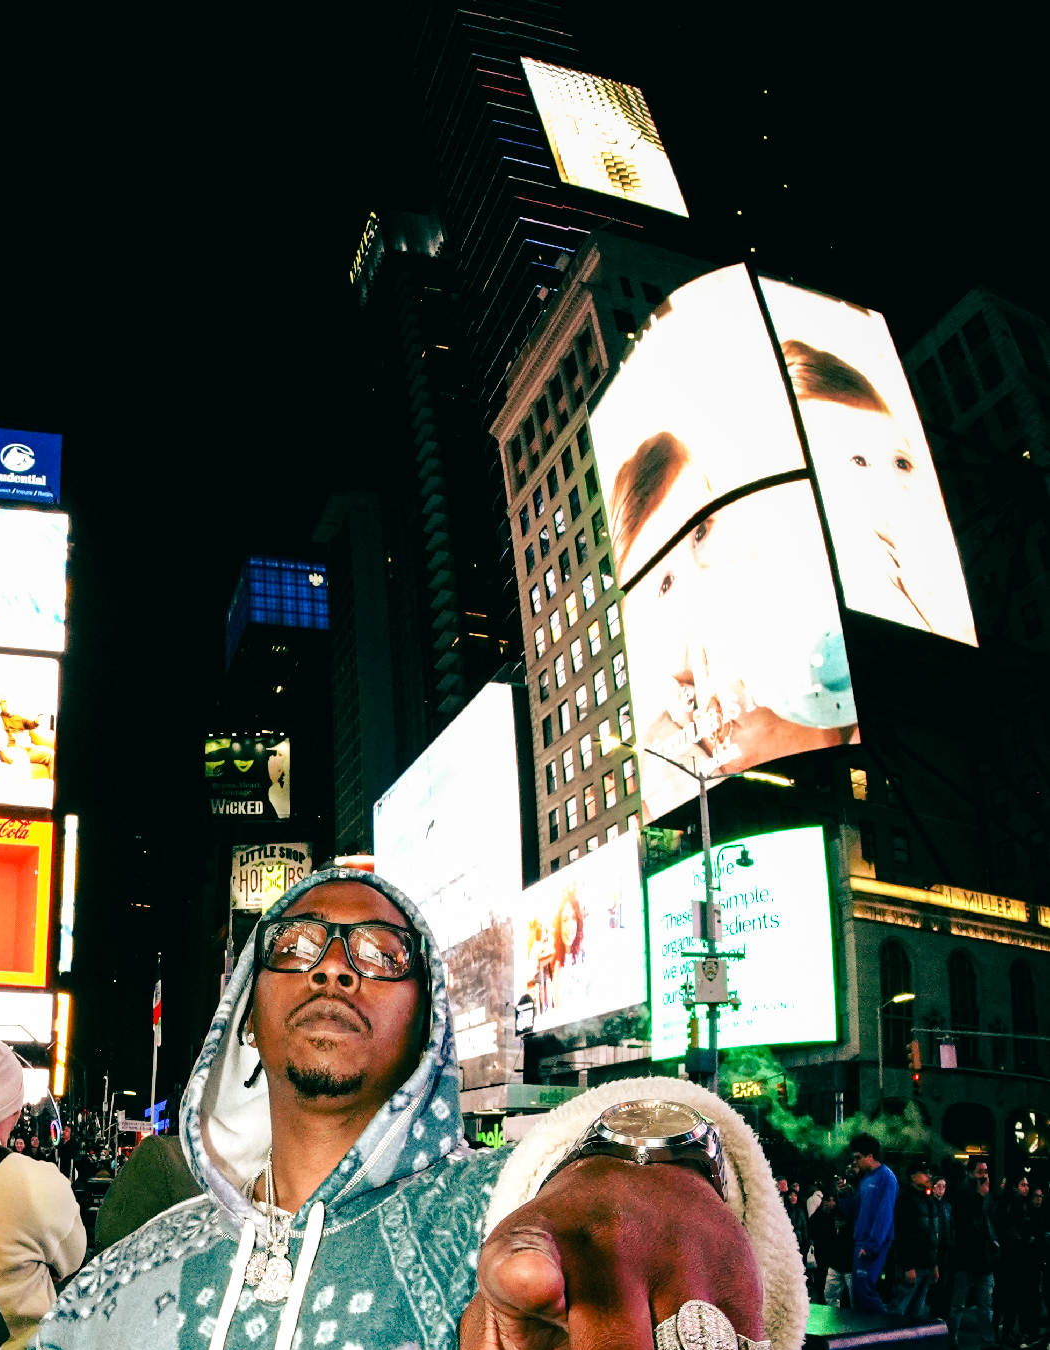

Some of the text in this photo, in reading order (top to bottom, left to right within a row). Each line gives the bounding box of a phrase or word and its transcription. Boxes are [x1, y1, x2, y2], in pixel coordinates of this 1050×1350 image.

[239, 846, 306, 866] LITTLE SHOP
[963, 891, 1014, 915] MILLER
